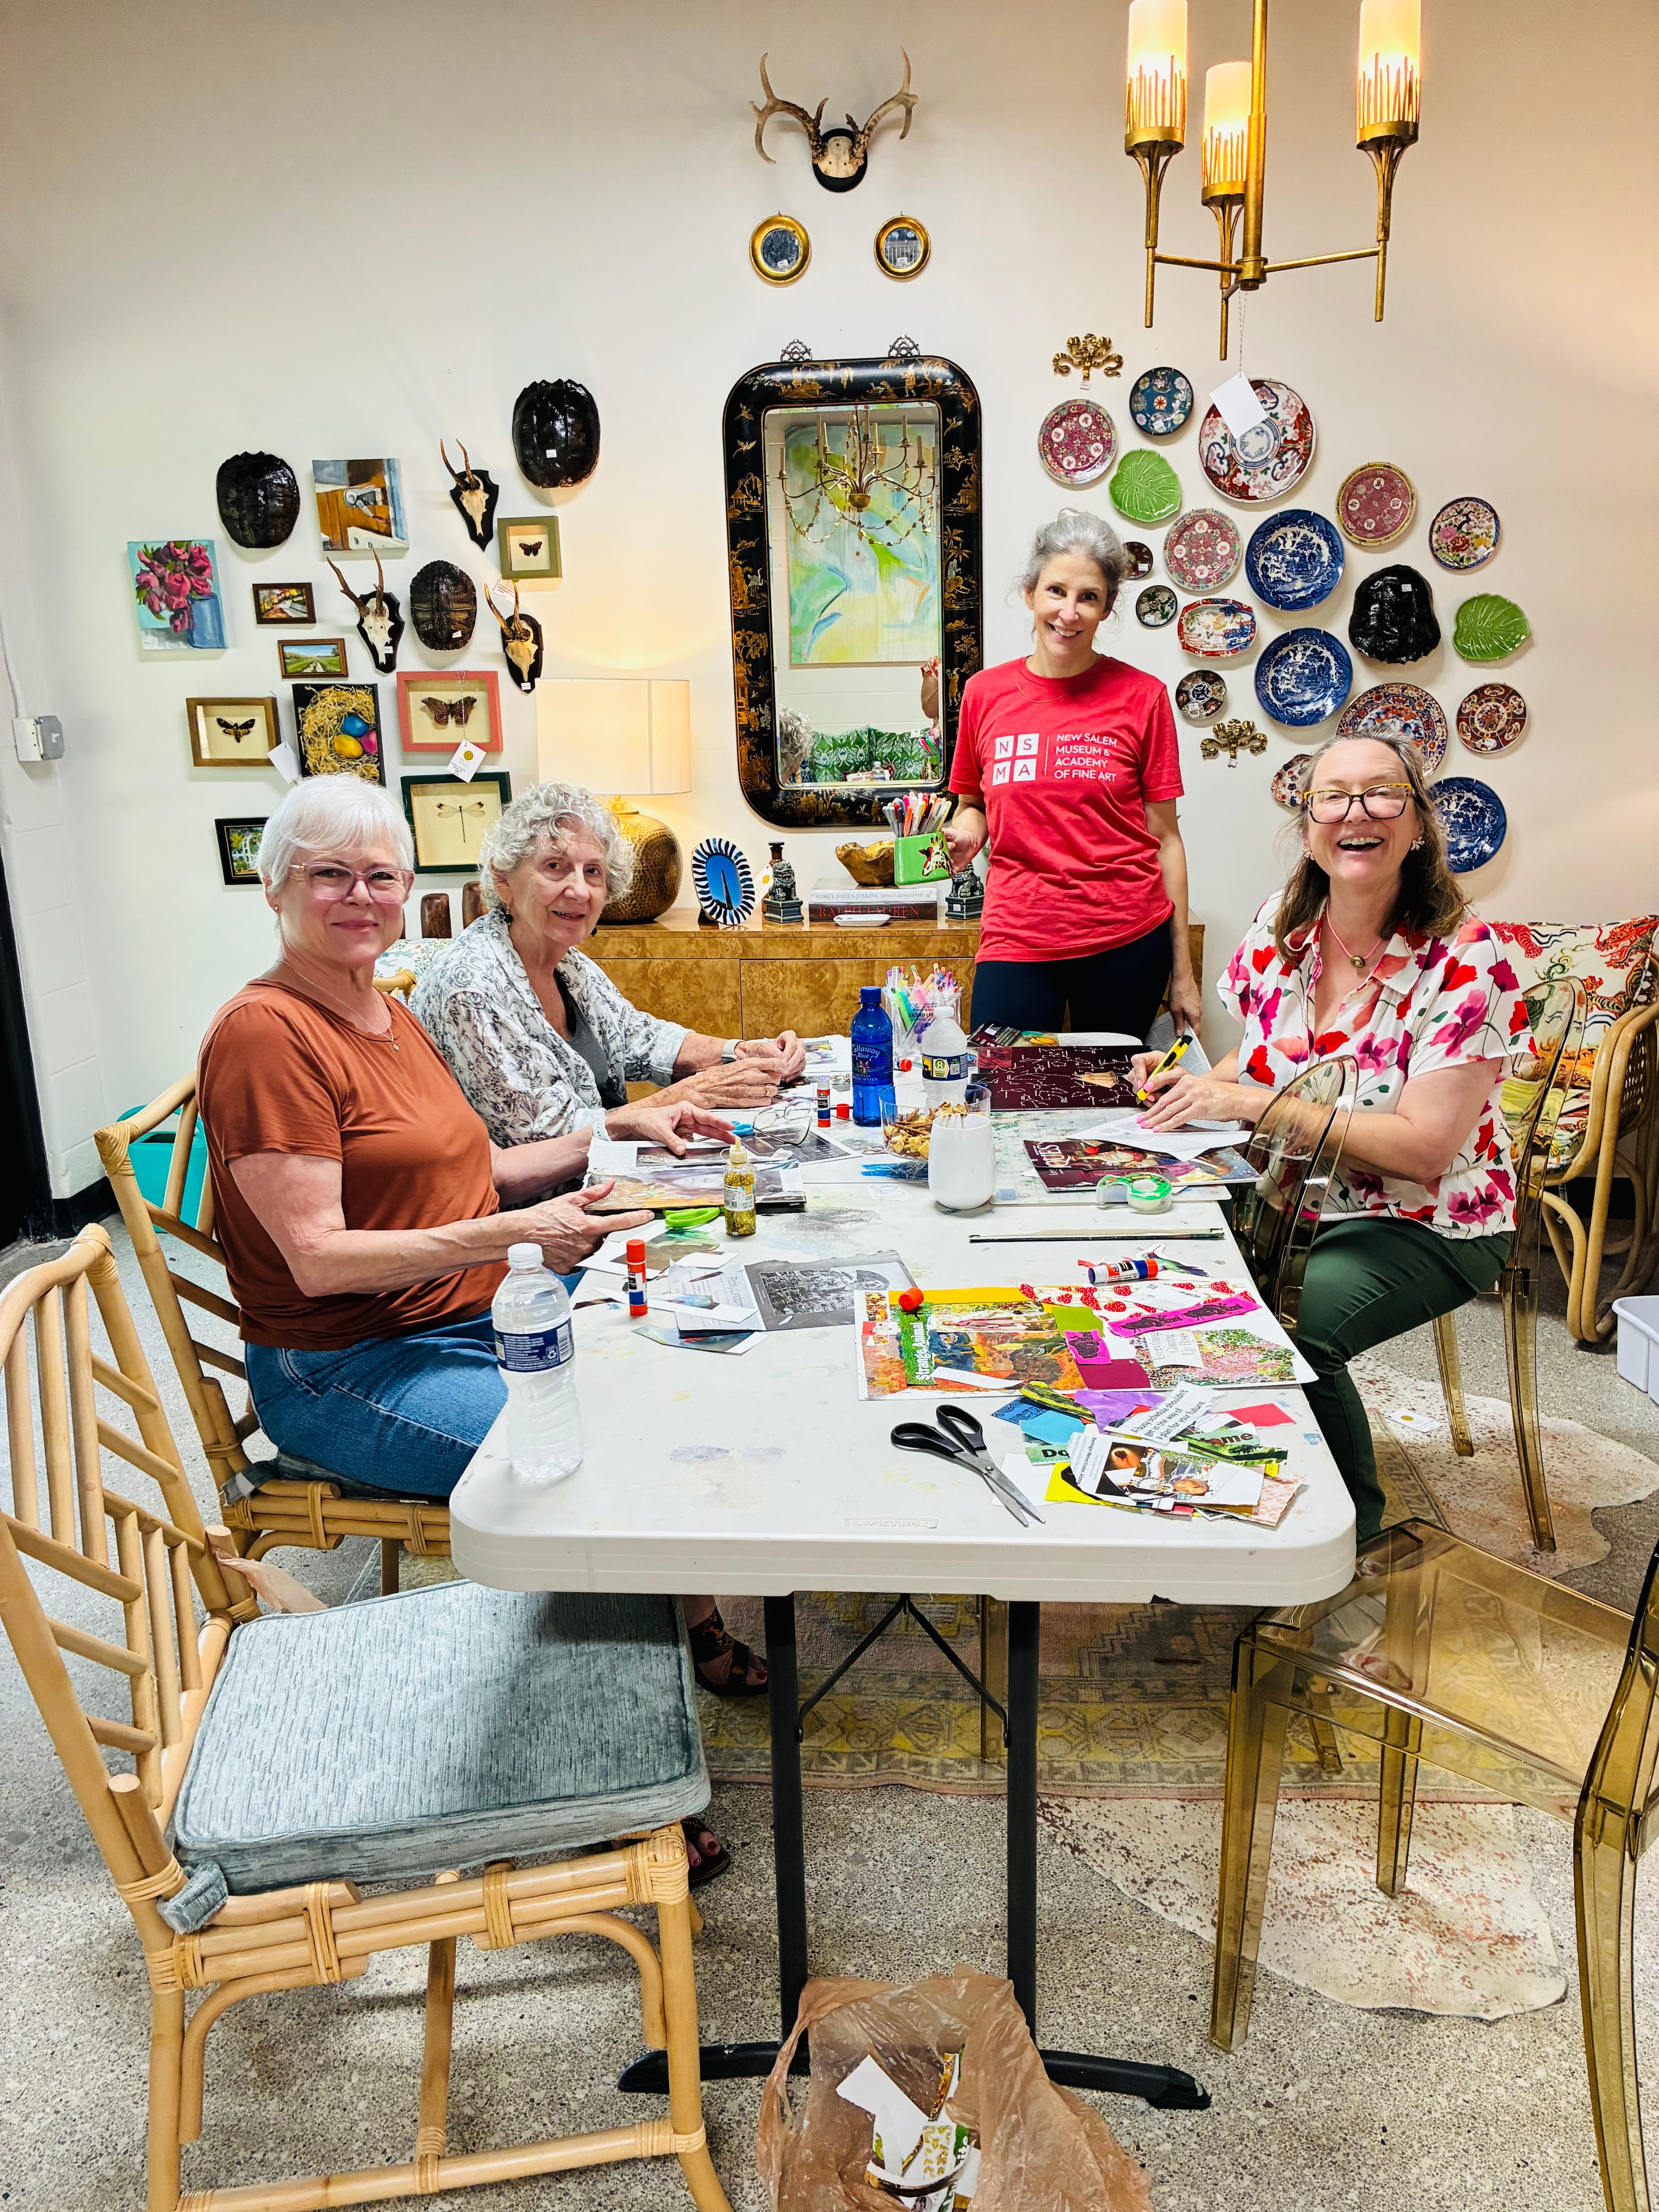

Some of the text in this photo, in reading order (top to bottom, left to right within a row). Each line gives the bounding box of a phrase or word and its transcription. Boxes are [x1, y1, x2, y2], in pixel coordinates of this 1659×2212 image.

[998, 738, 1032, 754] N S
[1084, 733, 1117, 747] SALEM
[1055, 745, 1101, 755] MUSEUM
[1055, 757, 1108, 768] ACADEMY
[995, 764, 1030, 780] M A
[1054, 769, 1116, 782] OF FINE ART
[909, 1322, 931, 1380] Strange Animal
[1149, 1332, 1165, 1360] Everything
[1164, 1334, 1179, 1353] Coming
[1137, 1421, 1151, 1430] busy
[1147, 1407, 1169, 1422] schedule
[1166, 1389, 1188, 1408] shouldn't
[1160, 1427, 1173, 1437] plan
[1170, 1421, 1180, 1429] for
[1178, 1414, 1190, 1423] your
[1185, 1401, 1206, 1415] future.
[1088, 1437, 1097, 1452] Barringer
[1200, 1433, 1254, 1446] ome
[1080, 1462, 1088, 1473] Crater,
[854, 1519, 930, 1528] LIFETIME
